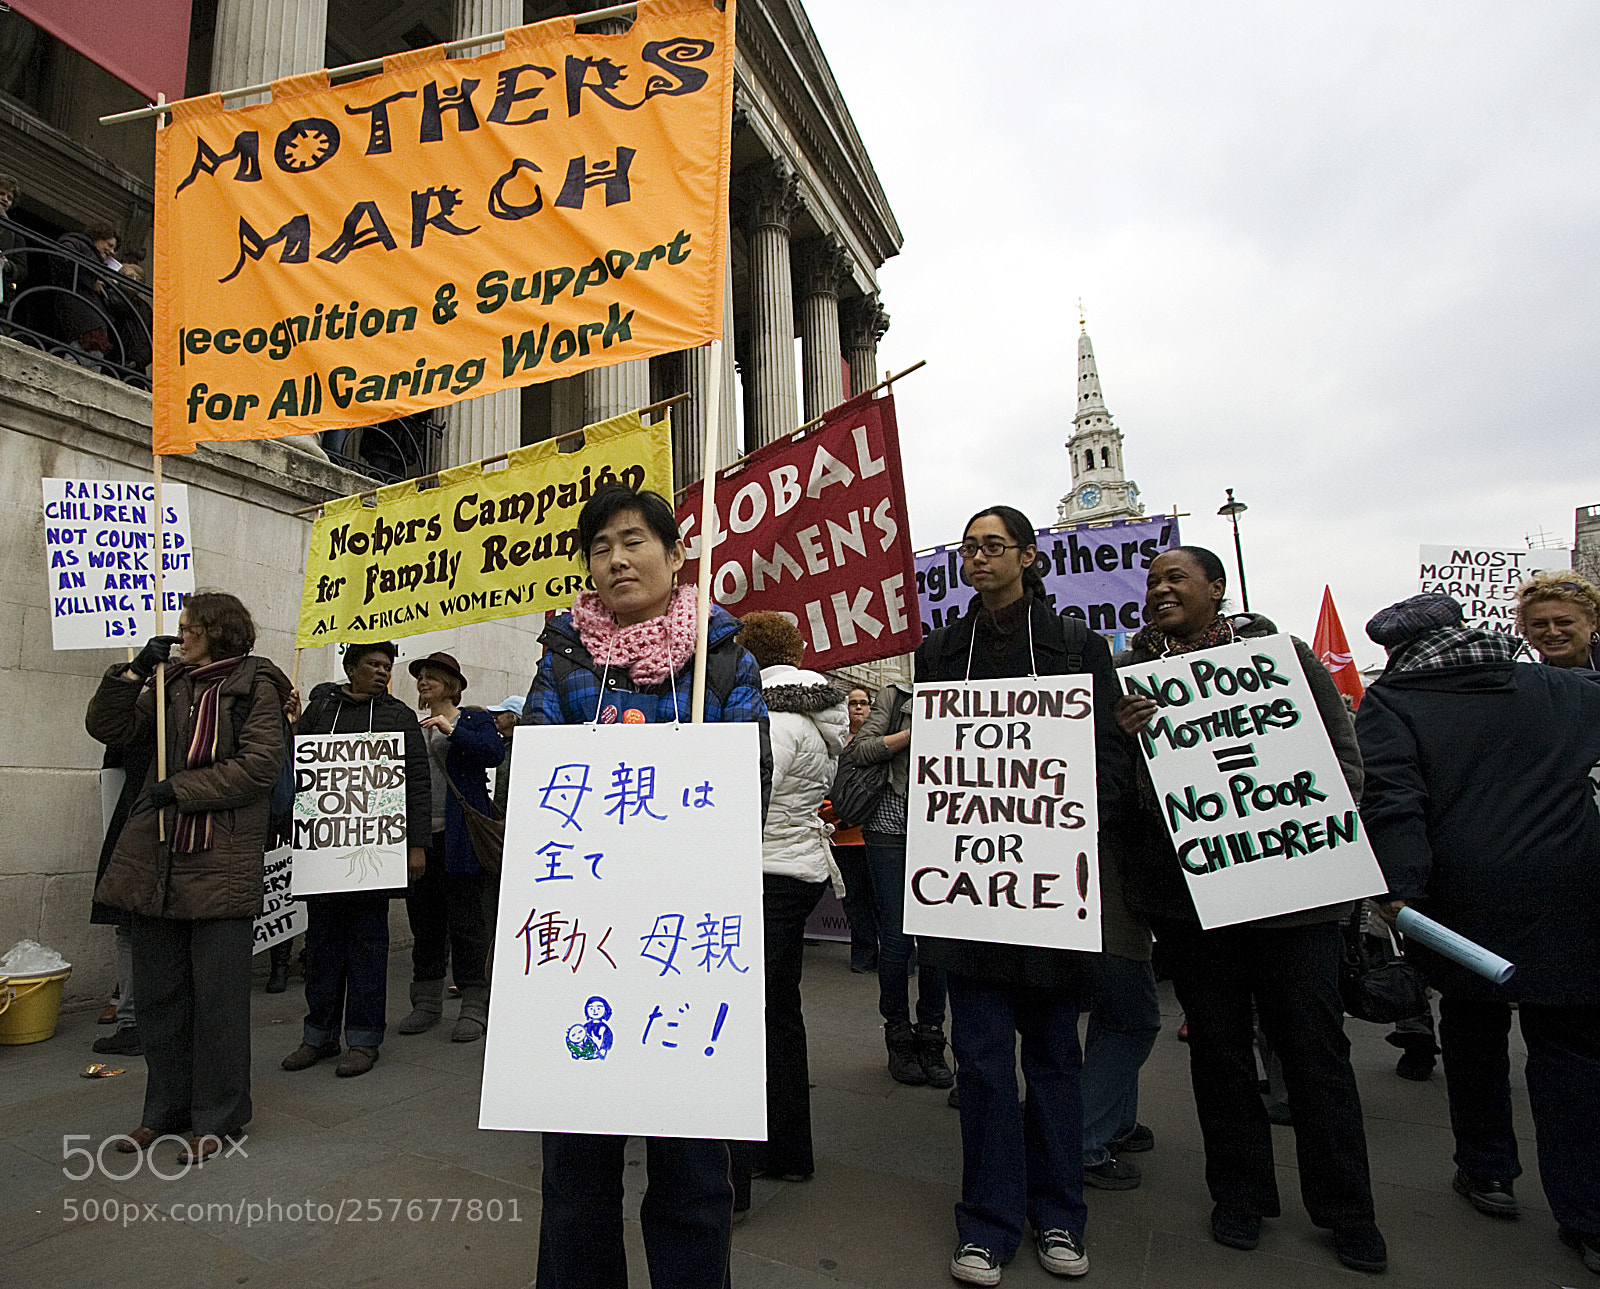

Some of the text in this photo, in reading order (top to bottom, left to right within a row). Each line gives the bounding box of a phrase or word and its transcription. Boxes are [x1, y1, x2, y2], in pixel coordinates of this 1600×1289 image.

[175, 37, 716, 199] MOTHERS
[218, 147, 637, 283] MARCH
[179, 230, 691, 366] ecognition & Support
[187, 303, 636, 423] for All Caring Work
[65, 481, 155, 501] RAISING
[680, 425, 886, 560] GLOBAL
[45, 501, 146, 524] CHILDREN
[47, 528, 185, 549] NOT COUNTED
[328, 513, 442, 561] Mothers
[709, 497, 898, 605] OMEN'S
[1037, 526, 1171, 577] others'
[51, 550, 190, 570] AS WORK BUT
[315, 528, 580, 606] for Family Reun
[1450, 550, 1526, 567] MOST
[59, 571, 166, 590] AN ARMY
[1421, 581, 1480, 598] EARN
[55, 594, 135, 617] KILLING
[347, 601, 430, 633] AFRICAN
[439, 581, 535, 617] WOMEN'S
[779, 572, 908, 653] IKE
[1472, 600, 1516, 619] RAIS
[105, 617, 137, 638] IS!
[1124, 653, 1291, 709] NO POOR
[916, 688, 1091, 719] TRILLIONS
[955, 721, 1031, 750] FOR
[1139, 698, 1301, 760] MOTHERS
[296, 739, 406, 764] SURVIVAL
[295, 764, 406, 793] DEPENDS
[917, 756, 1067, 795] KILLING
[317, 790, 370, 815] ON
[926, 790, 1086, 830] PEANUTS
[1165, 770, 1329, 834] NO POOR
[293, 813, 407, 850] MOTHERS
[954, 833, 1024, 864] FOR
[1178, 810, 1358, 876] CHILDREN
[534, 840, 606, 883] 全て
[263, 871, 292, 894] ERY
[253, 910, 297, 946] GHT
